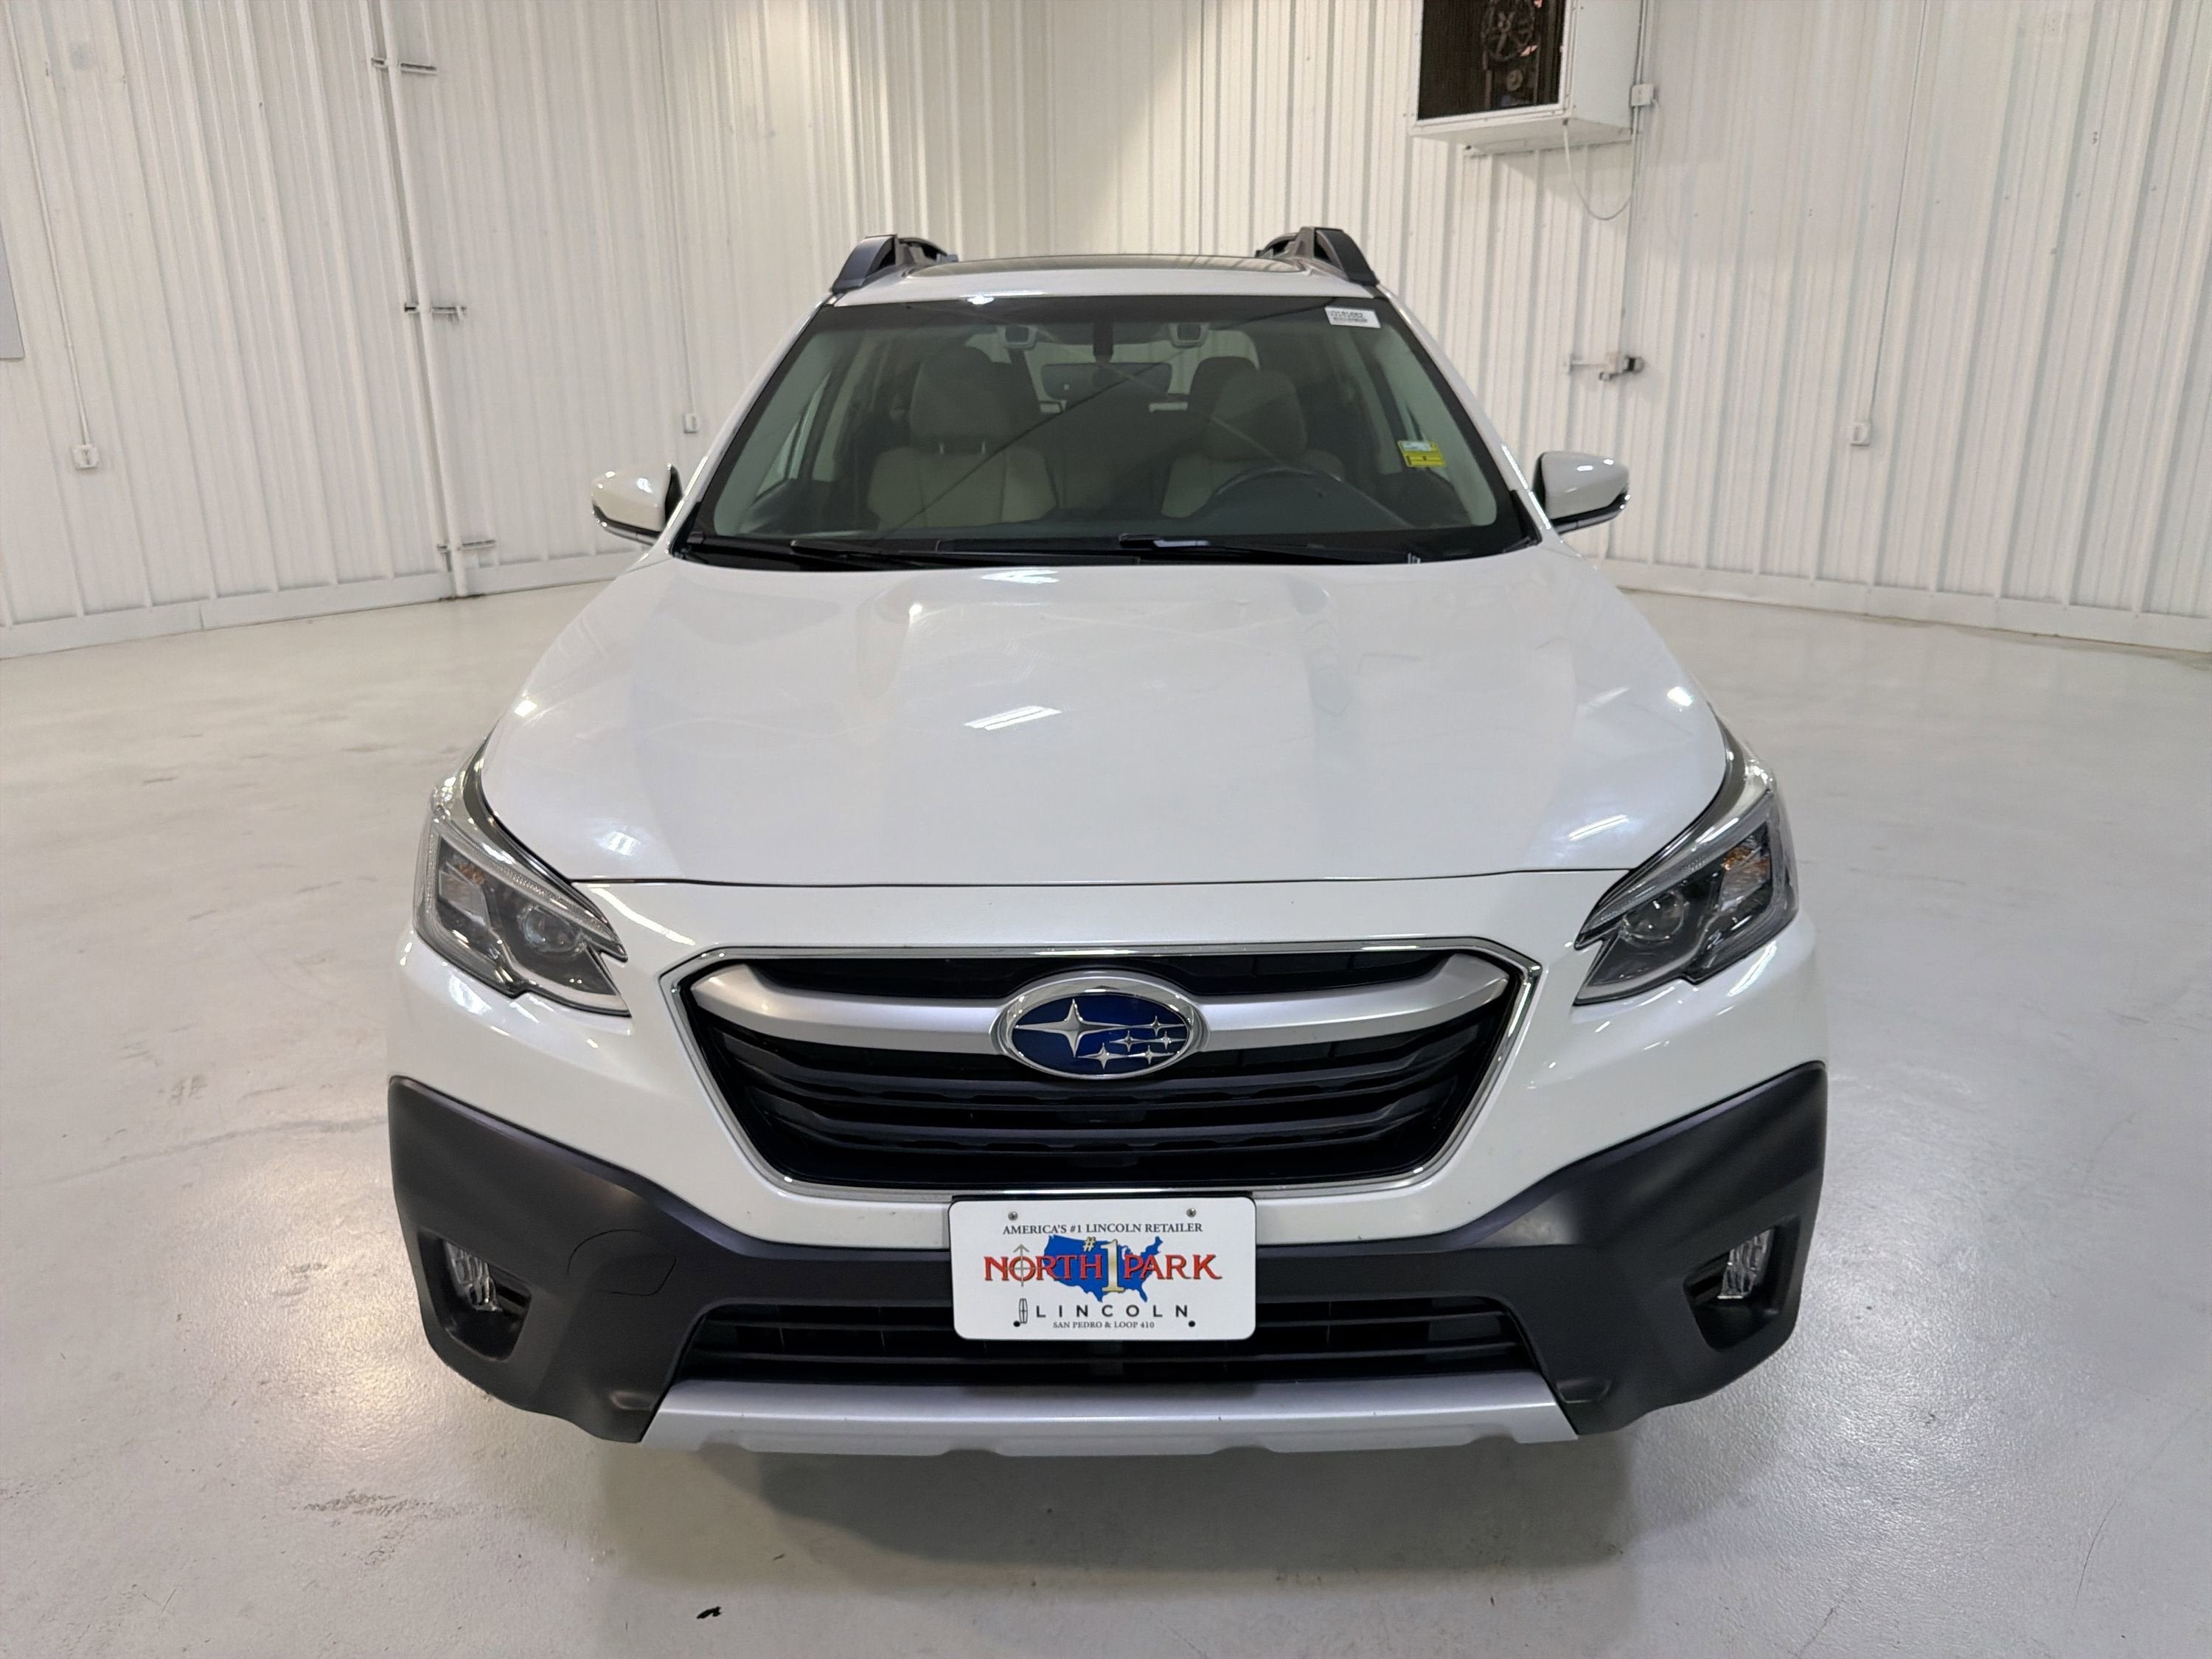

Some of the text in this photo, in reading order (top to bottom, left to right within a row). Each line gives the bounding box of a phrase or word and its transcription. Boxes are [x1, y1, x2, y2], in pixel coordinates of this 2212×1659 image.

[1003, 1222, 1203, 1235] AMERICA'S #1 LINCOLN RETAILER
[984, 1253, 1222, 1281] NORTH PARK
[1036, 1304, 1188, 1318] LINCOLN
